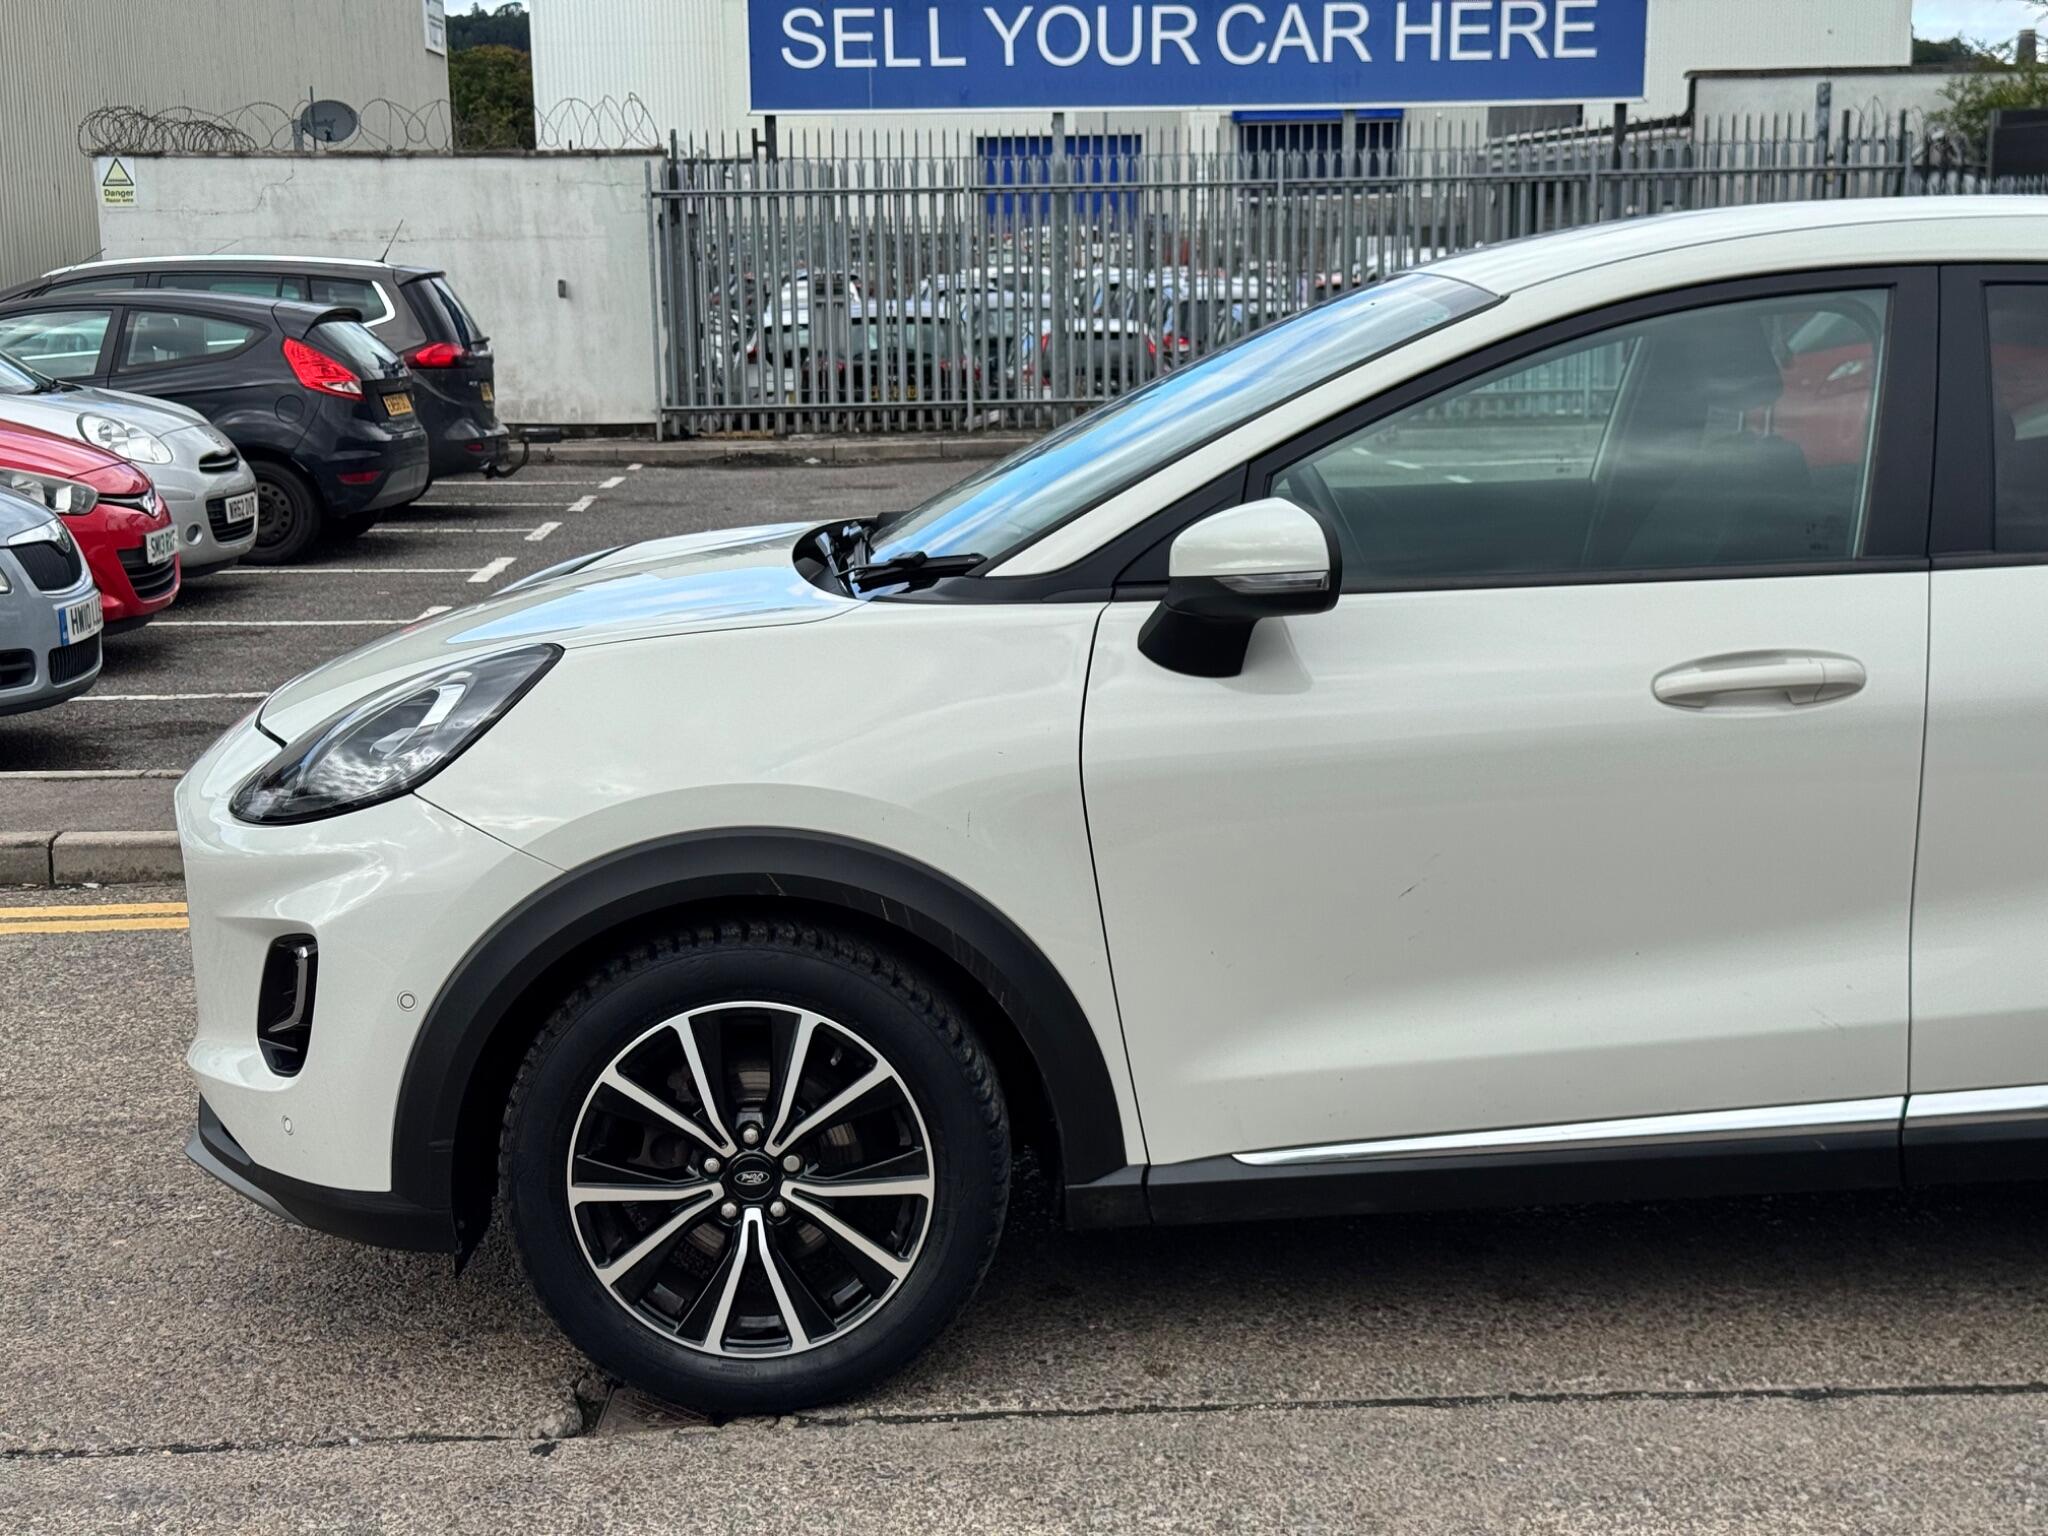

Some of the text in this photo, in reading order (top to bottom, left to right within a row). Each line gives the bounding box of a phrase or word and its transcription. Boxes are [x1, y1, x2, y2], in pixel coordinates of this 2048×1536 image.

[780, 0, 1598, 69] SELL YOUR CAR HERE
[104, 189, 134, 198] Danger
[741, 1172, 764, 1184] Ford
